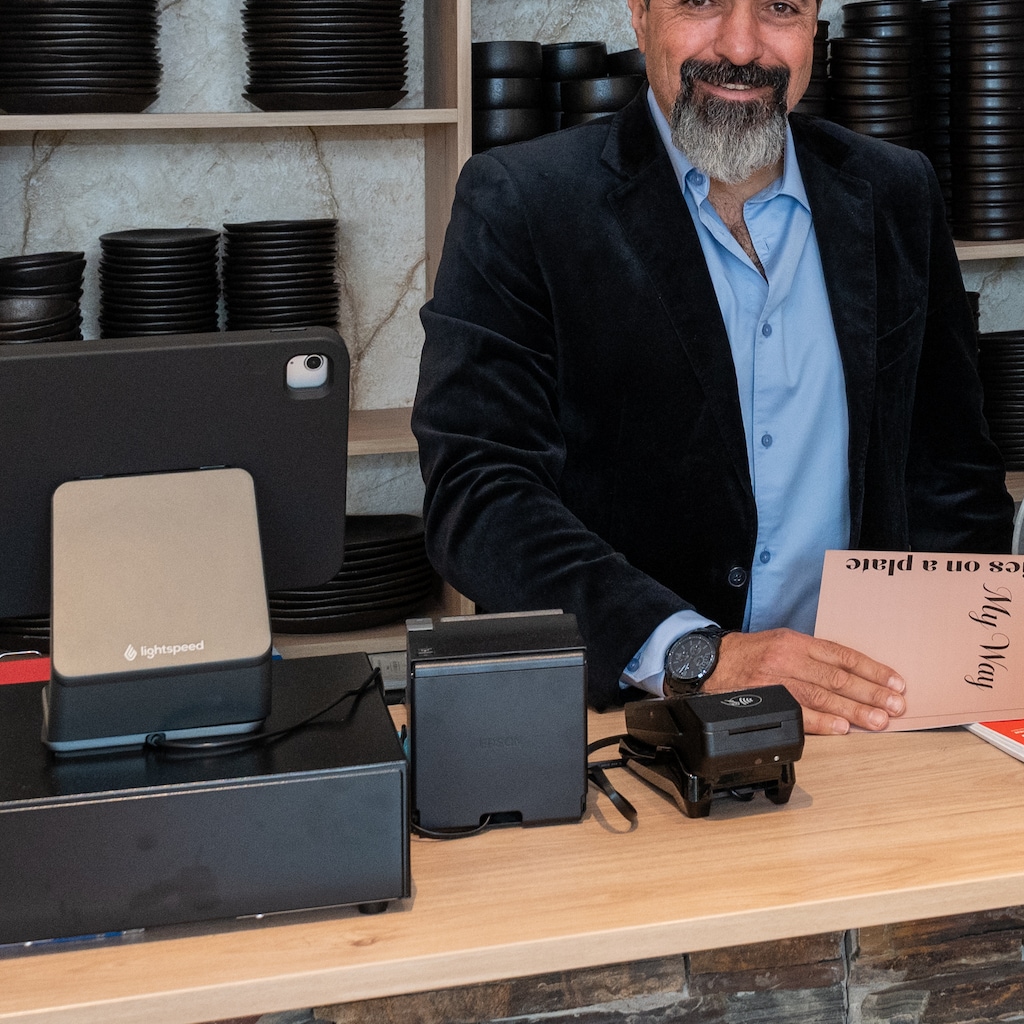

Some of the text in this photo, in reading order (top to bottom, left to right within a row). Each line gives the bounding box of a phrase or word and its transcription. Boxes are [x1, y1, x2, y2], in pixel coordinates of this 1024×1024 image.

[845, 554, 913, 576] plate
[922, 559, 937, 572] a
[946, 560, 980, 572] on
[964, 582, 1013, 691] My Way
[140, 639, 204, 659] lightspeed
